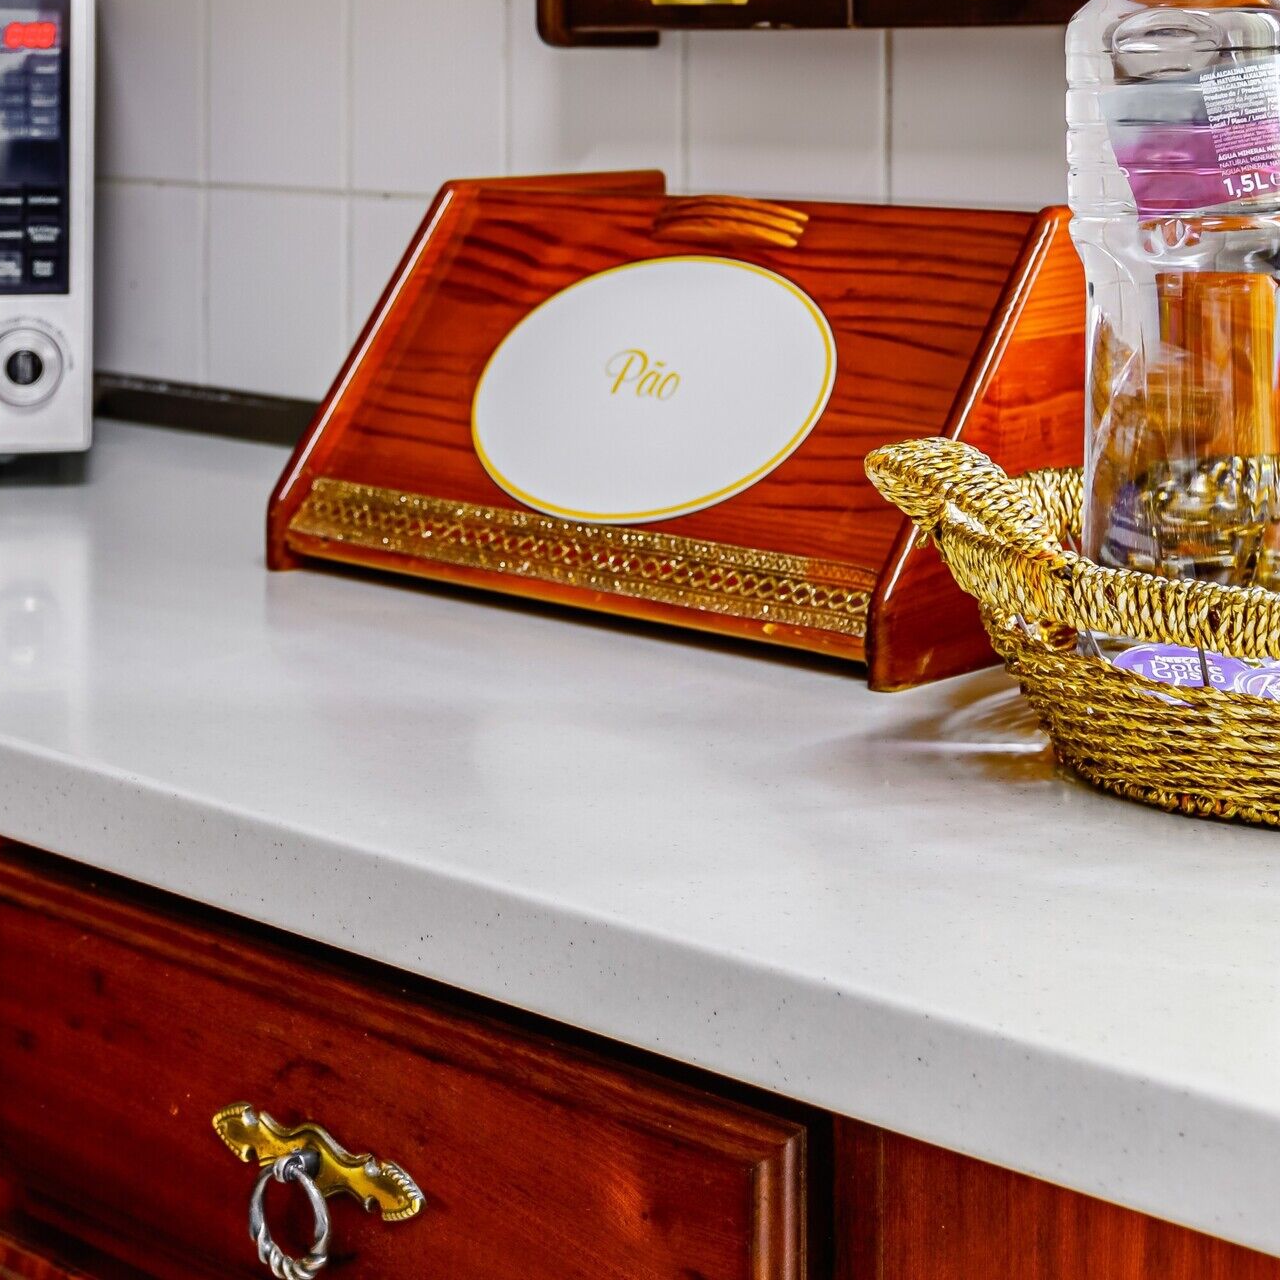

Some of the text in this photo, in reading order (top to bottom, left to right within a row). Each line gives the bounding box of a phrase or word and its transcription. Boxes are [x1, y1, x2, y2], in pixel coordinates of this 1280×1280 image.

[1238, 146, 1266, 157] MINERAL
[1223, 172, 1269, 198] 1,5L
[605, 348, 681, 400] Pão
[1154, 655, 1215, 665] NESCA
[1151, 668, 1226, 686] Guso
